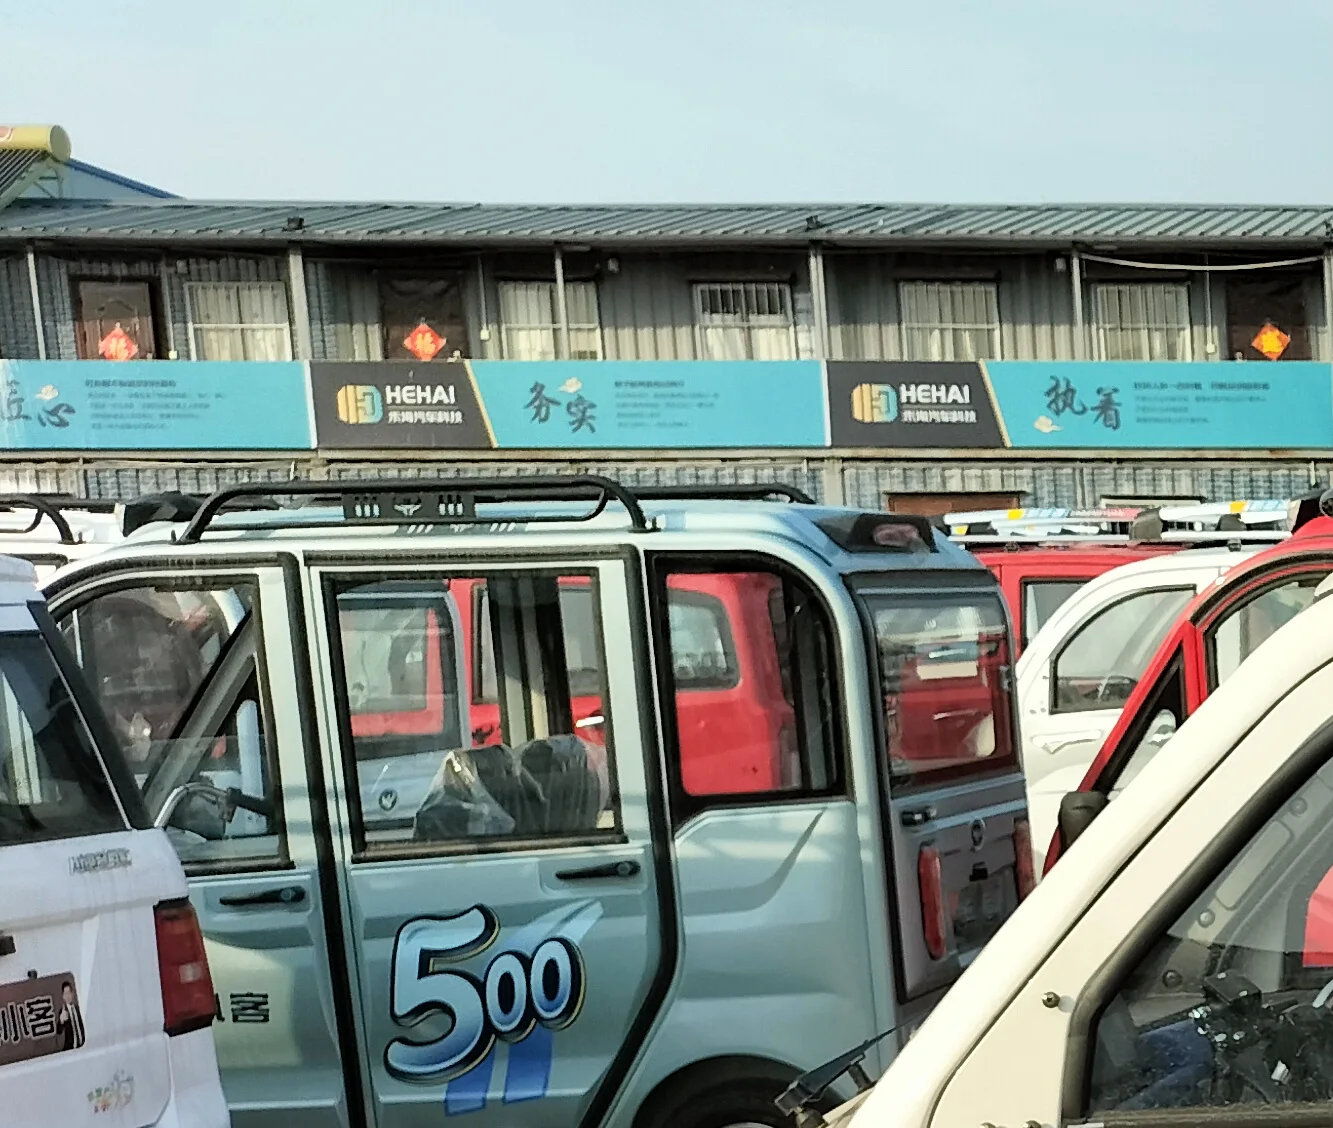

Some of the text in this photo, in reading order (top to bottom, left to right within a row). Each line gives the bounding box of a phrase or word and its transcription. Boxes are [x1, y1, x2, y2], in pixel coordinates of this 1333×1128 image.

[385, 384, 456, 405] HEHAI
[524, 381, 598, 433] 务实
[899, 383, 970, 404] HEHAI
[383, 903, 588, 1085] 500
